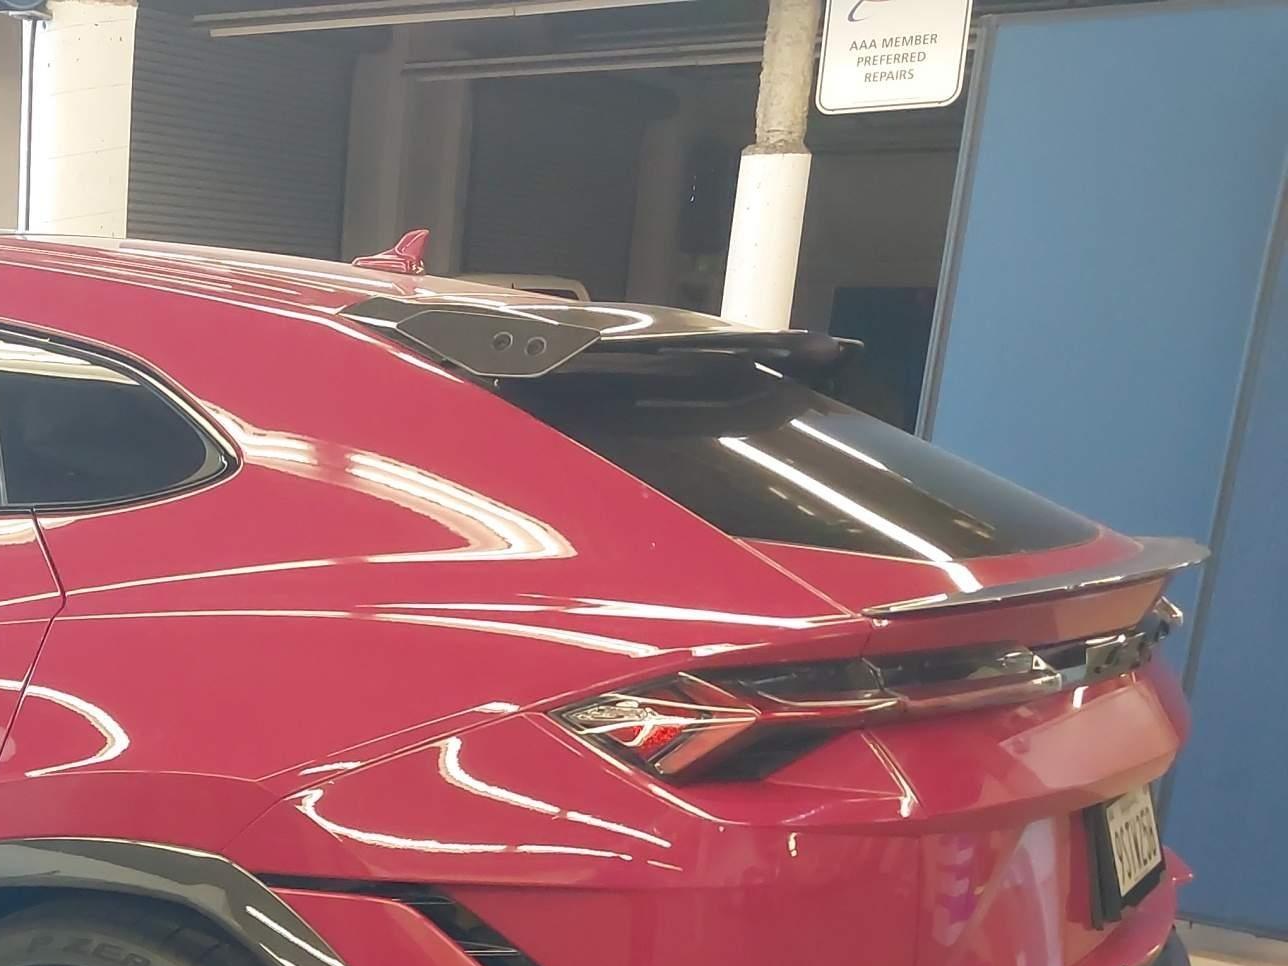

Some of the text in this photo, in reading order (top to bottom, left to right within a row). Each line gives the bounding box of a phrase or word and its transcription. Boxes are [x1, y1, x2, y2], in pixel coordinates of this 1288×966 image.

[849, 33, 938, 51] AAA MEMBER
[856, 51, 926, 67] PREFERRED
[864, 69, 914, 83] REPAIRS
